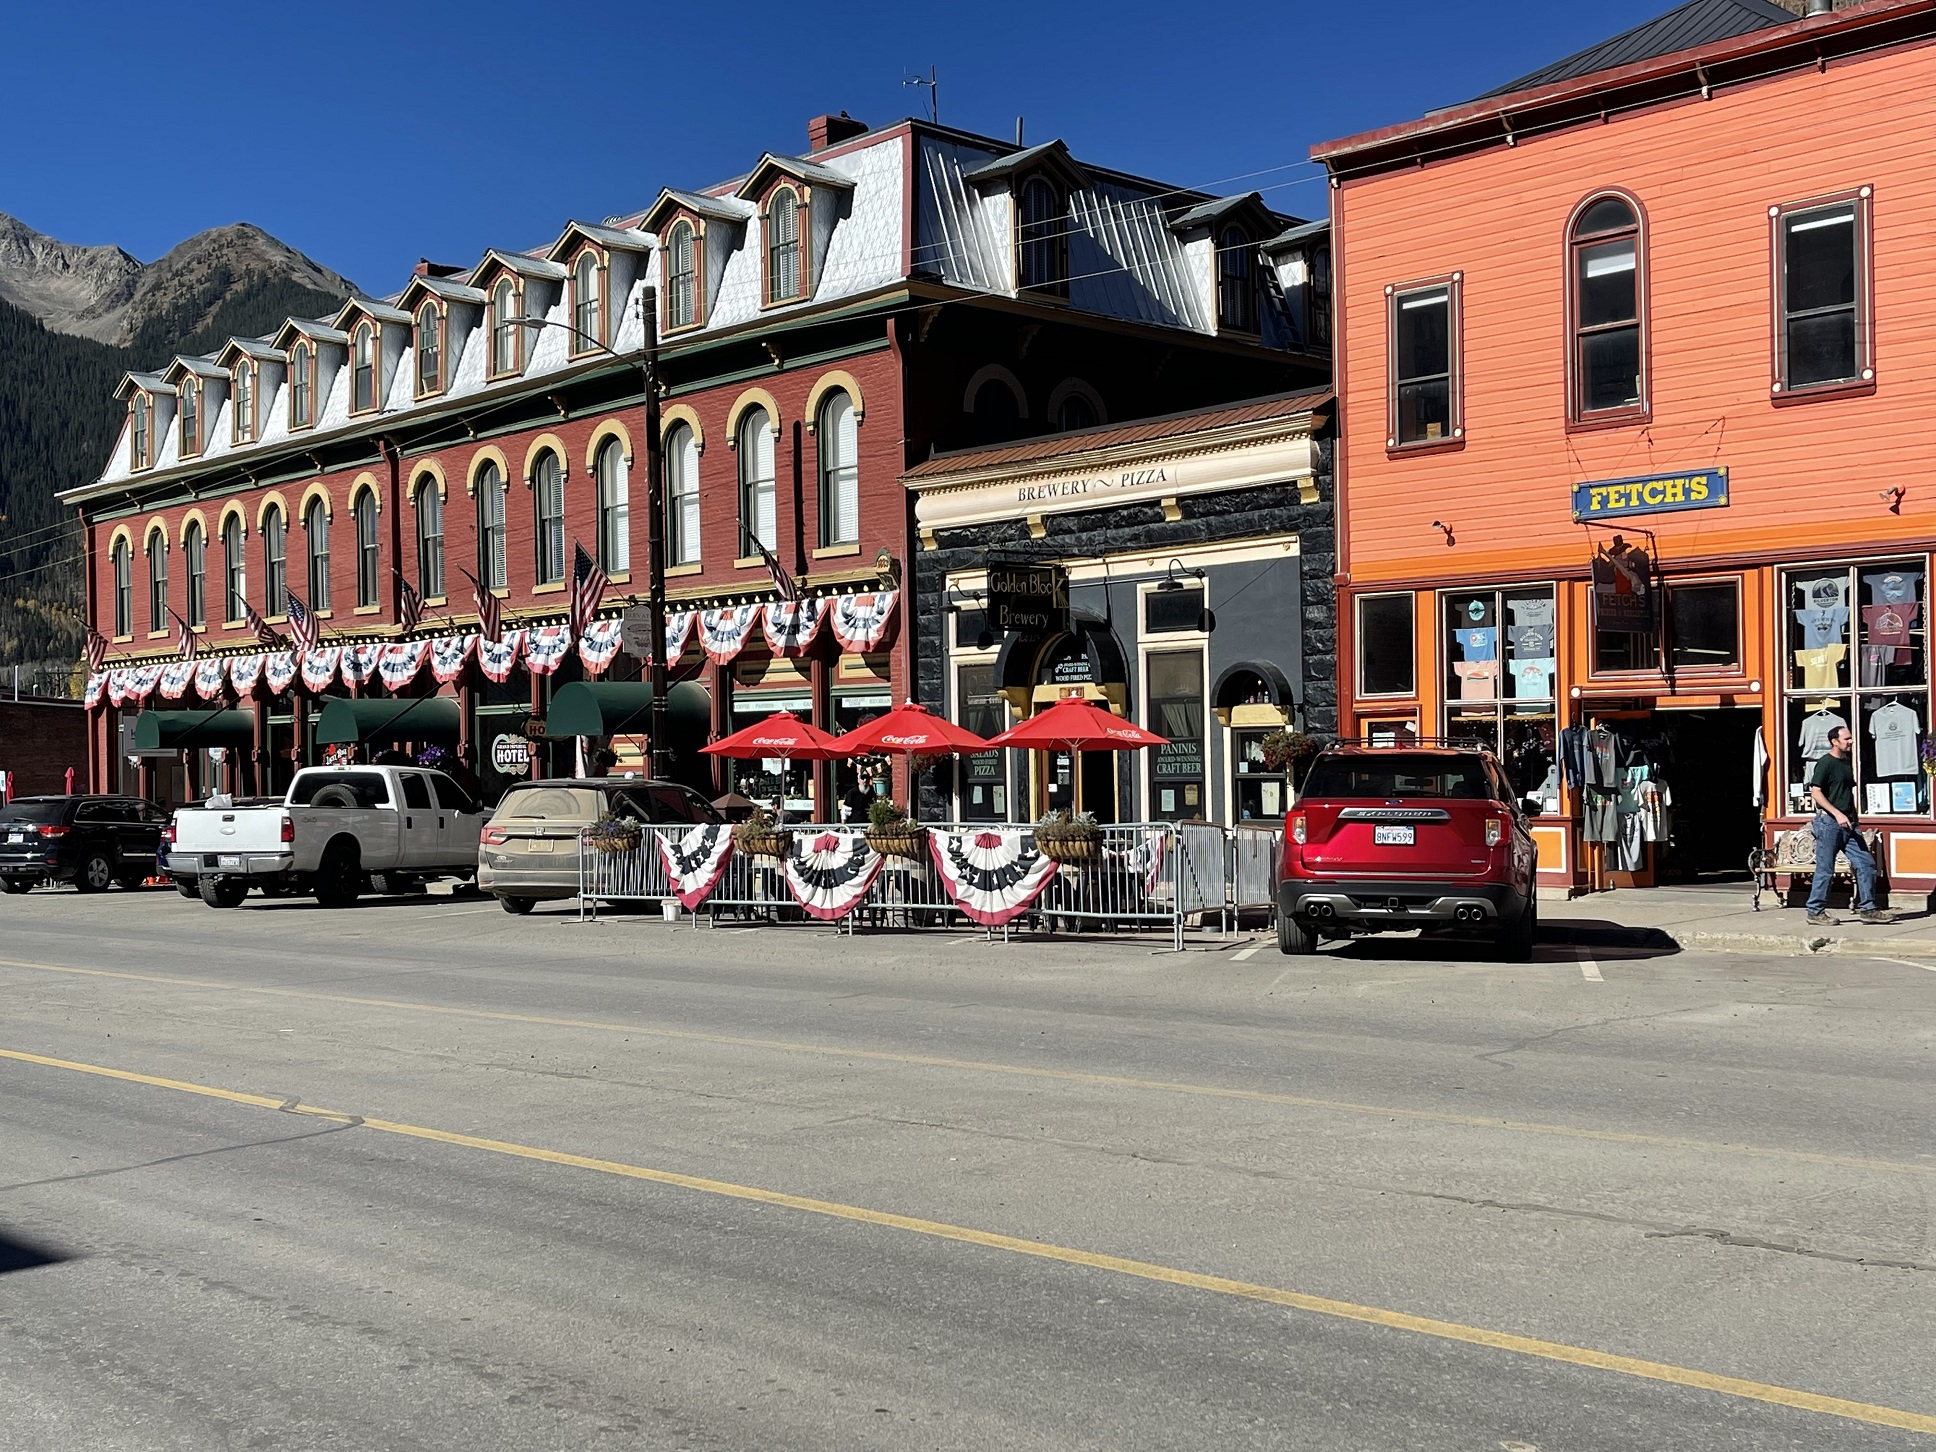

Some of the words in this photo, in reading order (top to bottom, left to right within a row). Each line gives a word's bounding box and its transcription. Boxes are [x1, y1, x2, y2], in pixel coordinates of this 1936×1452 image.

[1018, 479, 1091, 502] BREWERY
[1120, 468, 1167, 488] PIZZA
[1590, 476, 1709, 510] FETCH'S
[990, 571, 1027, 594] Golden
[1029, 568, 1069, 609] Block
[999, 604, 1049, 629] Brewery
[752, 736, 799, 746] Coca-Cola
[881, 734, 929, 745] Coca-Cola
[969, 749, 999, 759] SALADS
[1160, 743, 1197, 755] PANINIS
[496, 749, 530, 763] HOTEL
[974, 765, 996, 776] PIZZA
[1156, 763, 1181, 774] CRAFT
[1182, 762, 1202, 774] BEER
[1376, 832, 1413, 842] 8NFW599
